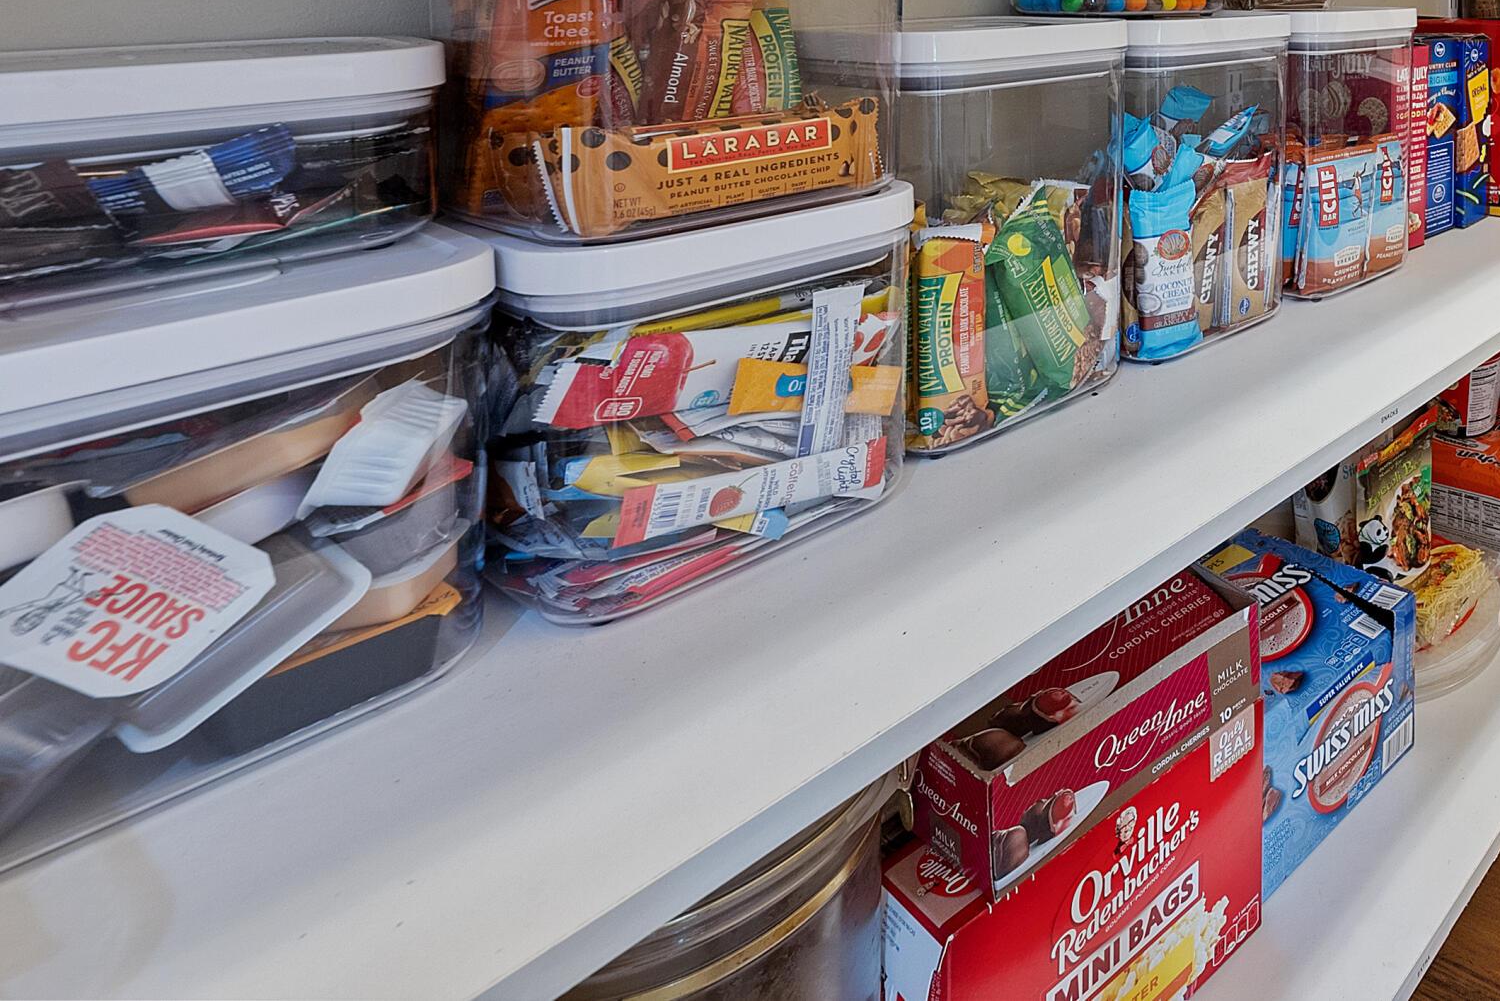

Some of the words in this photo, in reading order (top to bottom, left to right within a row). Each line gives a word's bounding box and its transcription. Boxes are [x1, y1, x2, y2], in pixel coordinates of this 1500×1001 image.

[543, 26, 589, 39] Chee
[544, 10, 594, 24] Toast
[552, 65, 592, 77] BUTTER
[554, 55, 596, 67] PEANUT
[722, 24, 742, 84] NATURE
[759, 35, 780, 104] PROTEIN
[1413, 66, 1429, 85] JULY
[663, 51, 690, 104] Almond
[682, 125, 820, 160] LÄRABAR
[656, 176, 694, 191] JUST
[699, 174, 709, 183] 4
[714, 168, 750, 181] REAL
[755, 152, 841, 175] INGREDIENTS
[670, 186, 711, 199] PEANUT
[714, 180, 751, 192] BUTTER
[753, 171, 808, 186] CHOCOLATE
[810, 165, 832, 176] CHIP
[1320, 170, 1337, 214] CLIF
[613, 198, 627, 207] NET
[629, 197, 642, 206] WT
[1322, 213, 1338, 221] BAR
[1200, 233, 1219, 304] CHEWY
[1247, 219, 1259, 290] CHEWY
[919, 278, 941, 328] VALLEY
[1155, 277, 1192, 292] COCONUT
[1162, 286, 1191, 300] CREAM
[1047, 285, 1073, 333] CRUNCHY
[937, 302, 953, 368] PROTEIN
[1043, 308, 1076, 363] NATURE
[919, 326, 943, 392] NATURE
[961, 352, 970, 375] PEANUT
[846, 446, 862, 486] Crystal
[84, 573, 206, 640] SAUCE
[1109, 627, 1160, 660] CORDIAL
[1160, 593, 1211, 628] CHERRIES
[67, 619, 171, 682] KFC
[1217, 658, 1244, 684] MILK
[1212, 666, 1249, 696] CHOCOLATE
[1318, 687, 1337, 708] SUPER
[1334, 674, 1352, 695] VALUE
[1349, 661, 1365, 680] PACK
[1218, 717, 1244, 750] Only
[1219, 706, 1233, 724] 10
[1094, 709, 1163, 774] Queen
[1151, 750, 1181, 775] CORDIAL
[1180, 725, 1211, 752] CHERRIES
[1212, 731, 1252, 769] REAL
[1292, 724, 1353, 799] SWISS
[1353, 677, 1394, 736] MISS
[1338, 744, 1366, 776] CHOCOLATE
[913, 767, 947, 811] Queen
[1071, 802, 1180, 925] Orville
[1050, 809, 1200, 976] Redenbacher's
[1128, 871, 1195, 953] BAGS
